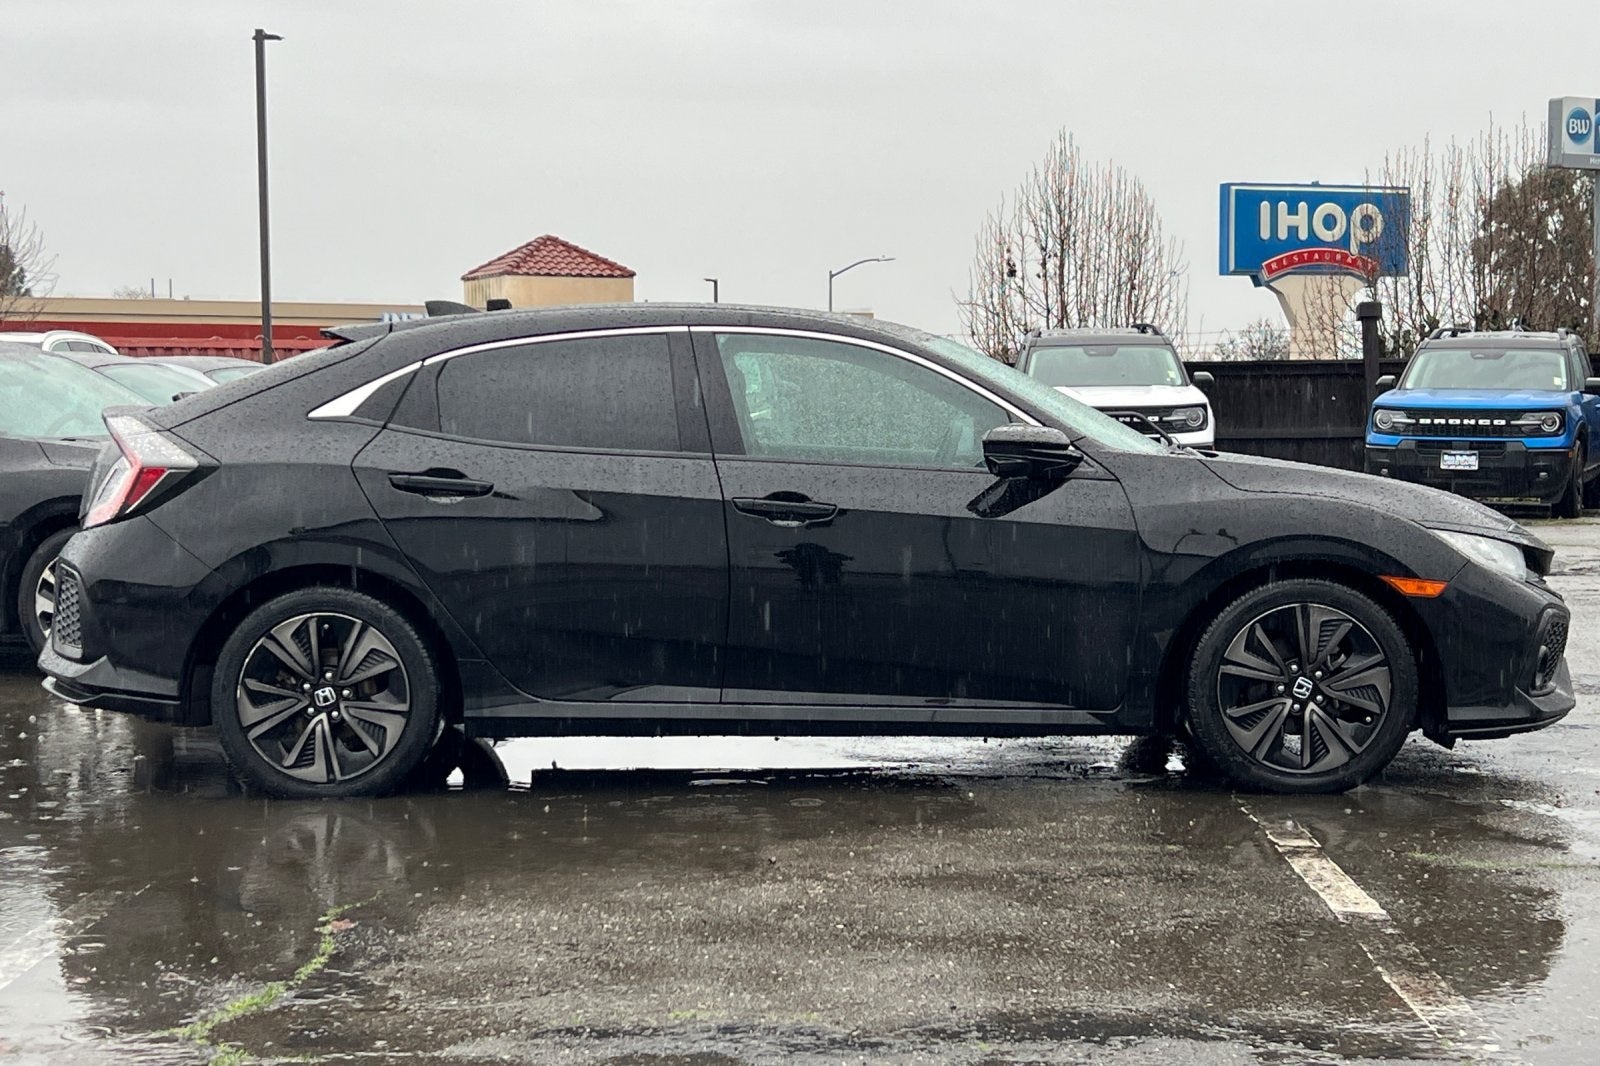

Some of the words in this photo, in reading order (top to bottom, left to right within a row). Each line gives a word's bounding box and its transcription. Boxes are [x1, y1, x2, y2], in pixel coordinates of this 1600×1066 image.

[1569, 118, 1590, 135] BW
[1259, 200, 1386, 256] IHOP
[1269, 251, 1373, 272] RESTAURANT
[1418, 417, 1507, 426] BRONCO
